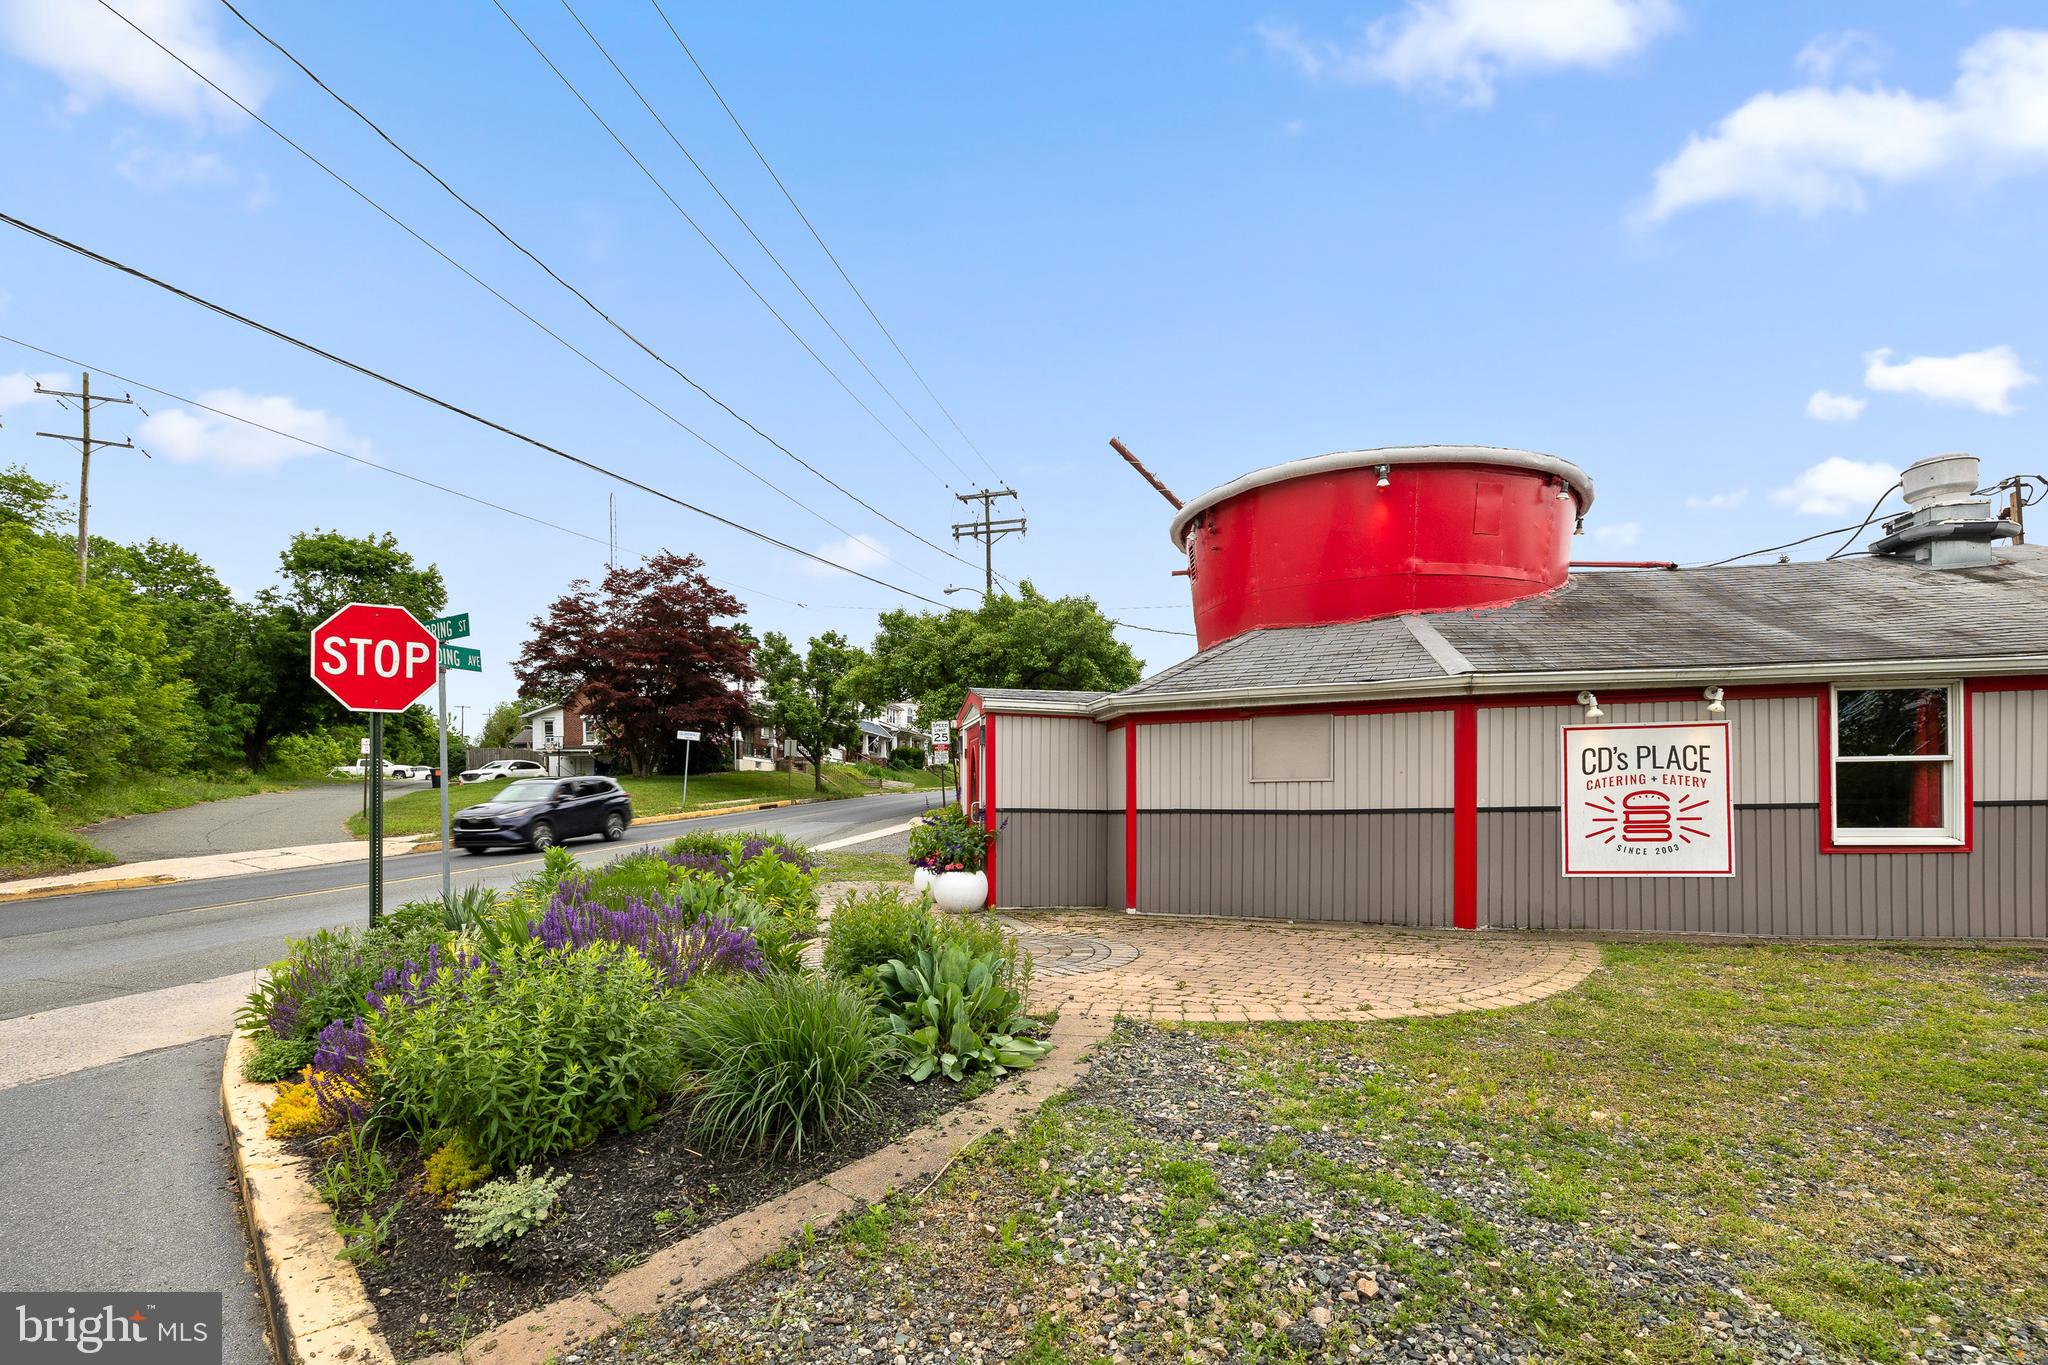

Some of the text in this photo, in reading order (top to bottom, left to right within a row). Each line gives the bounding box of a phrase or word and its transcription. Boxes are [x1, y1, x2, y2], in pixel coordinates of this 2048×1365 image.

[458, 619, 467, 632] ST
[321, 636, 430, 678] STOP
[467, 655, 481, 667] AVE
[934, 733, 949, 742] 25
[1581, 745, 1712, 775] CD's PLACE
[1586, 774, 1646, 790] CATERING
[1662, 774, 1707, 788] EATERY
[1616, 843, 1680, 855] SINCE 2003
